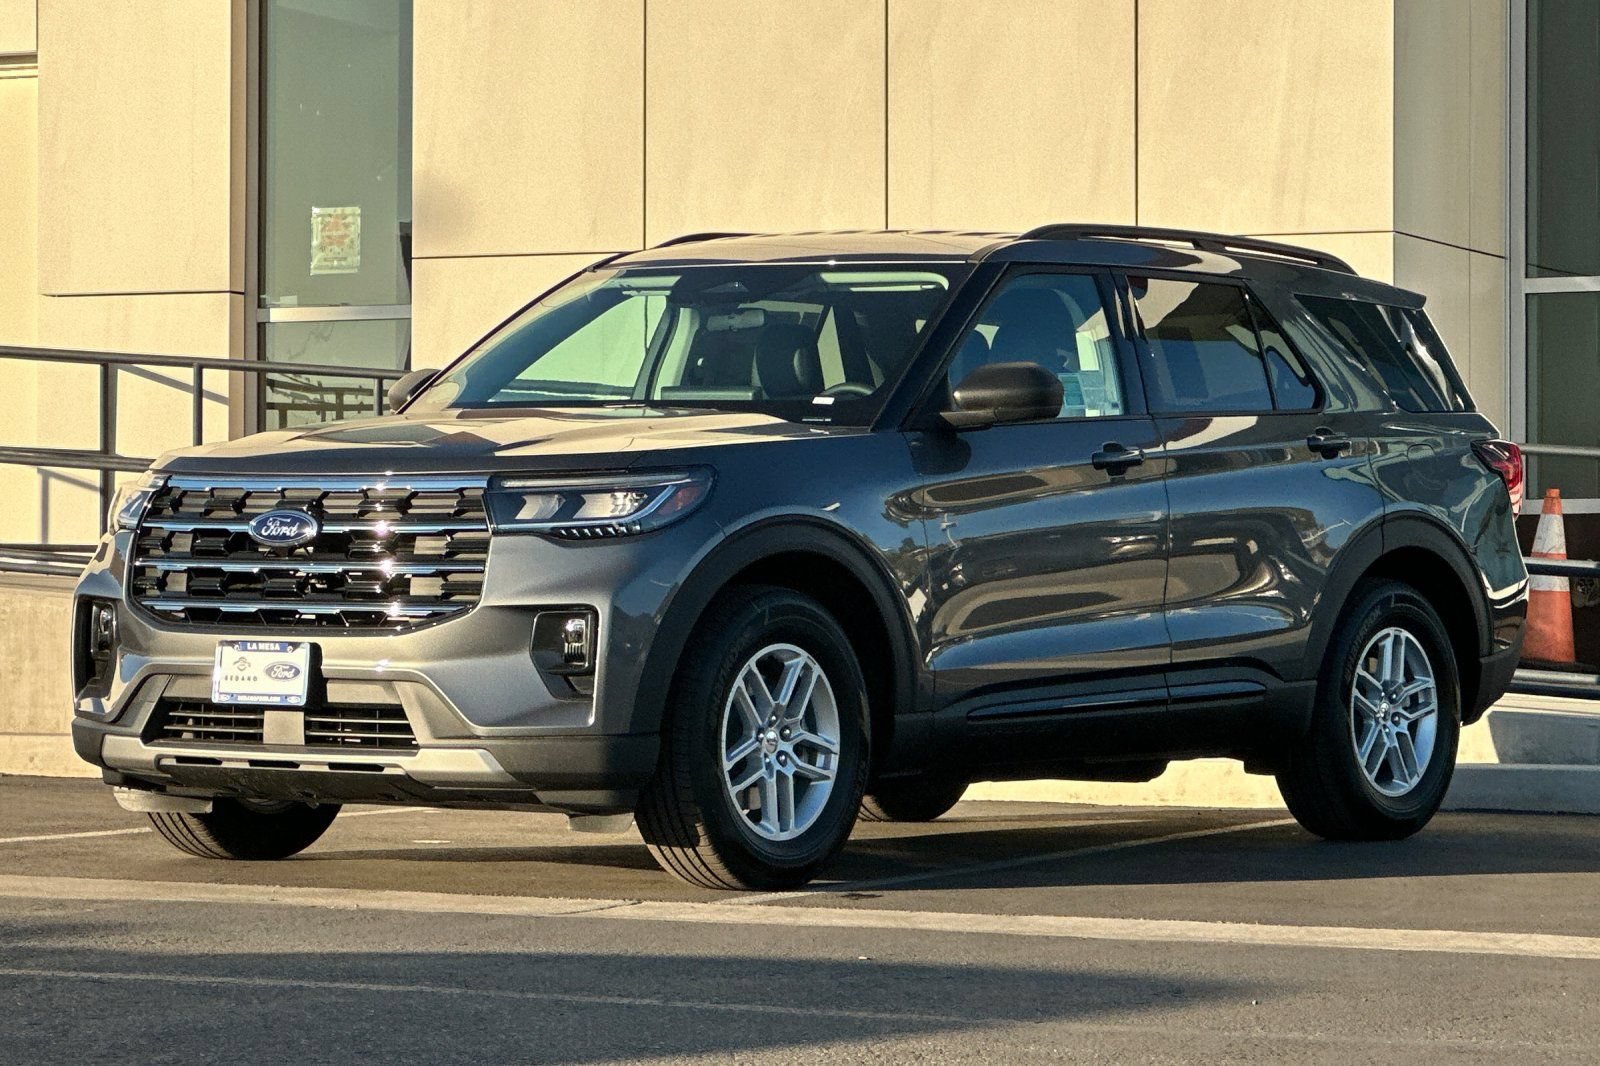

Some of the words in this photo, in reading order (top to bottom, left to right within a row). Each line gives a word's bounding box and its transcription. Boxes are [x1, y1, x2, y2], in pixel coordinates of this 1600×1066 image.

[261, 517, 299, 537] Ford
[247, 642, 257, 650] LA
[258, 642, 281, 651] MESA
[270, 663, 295, 679] Ford
